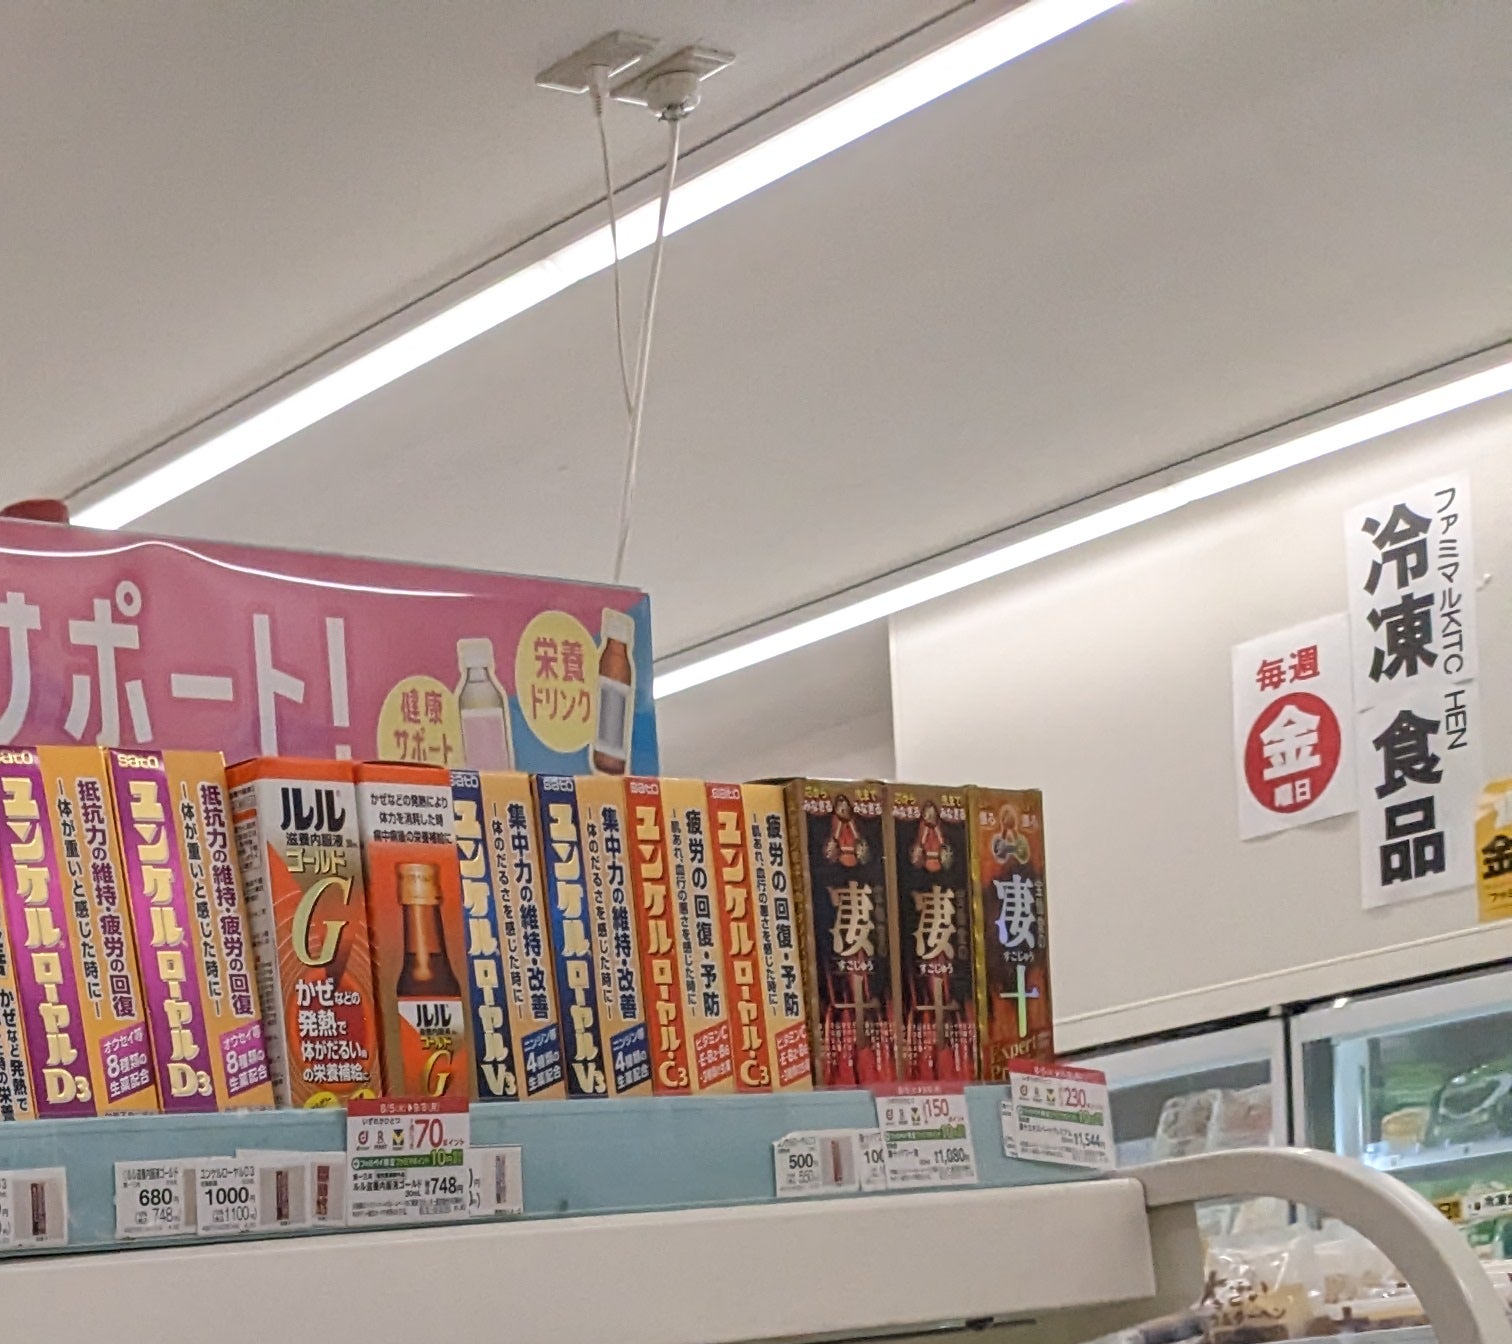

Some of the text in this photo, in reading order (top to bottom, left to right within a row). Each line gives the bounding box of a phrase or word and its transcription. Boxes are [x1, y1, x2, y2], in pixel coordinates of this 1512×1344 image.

[533, 637, 585, 683] 栄養
[1255, 644, 1321, 692] 毎週
[401, 688, 444, 723] 健康
[531, 684, 591, 721] ドリンク
[394, 727, 453, 763] サポート
[280, 787, 346, 832] ルル
[292, 877, 355, 968] G
